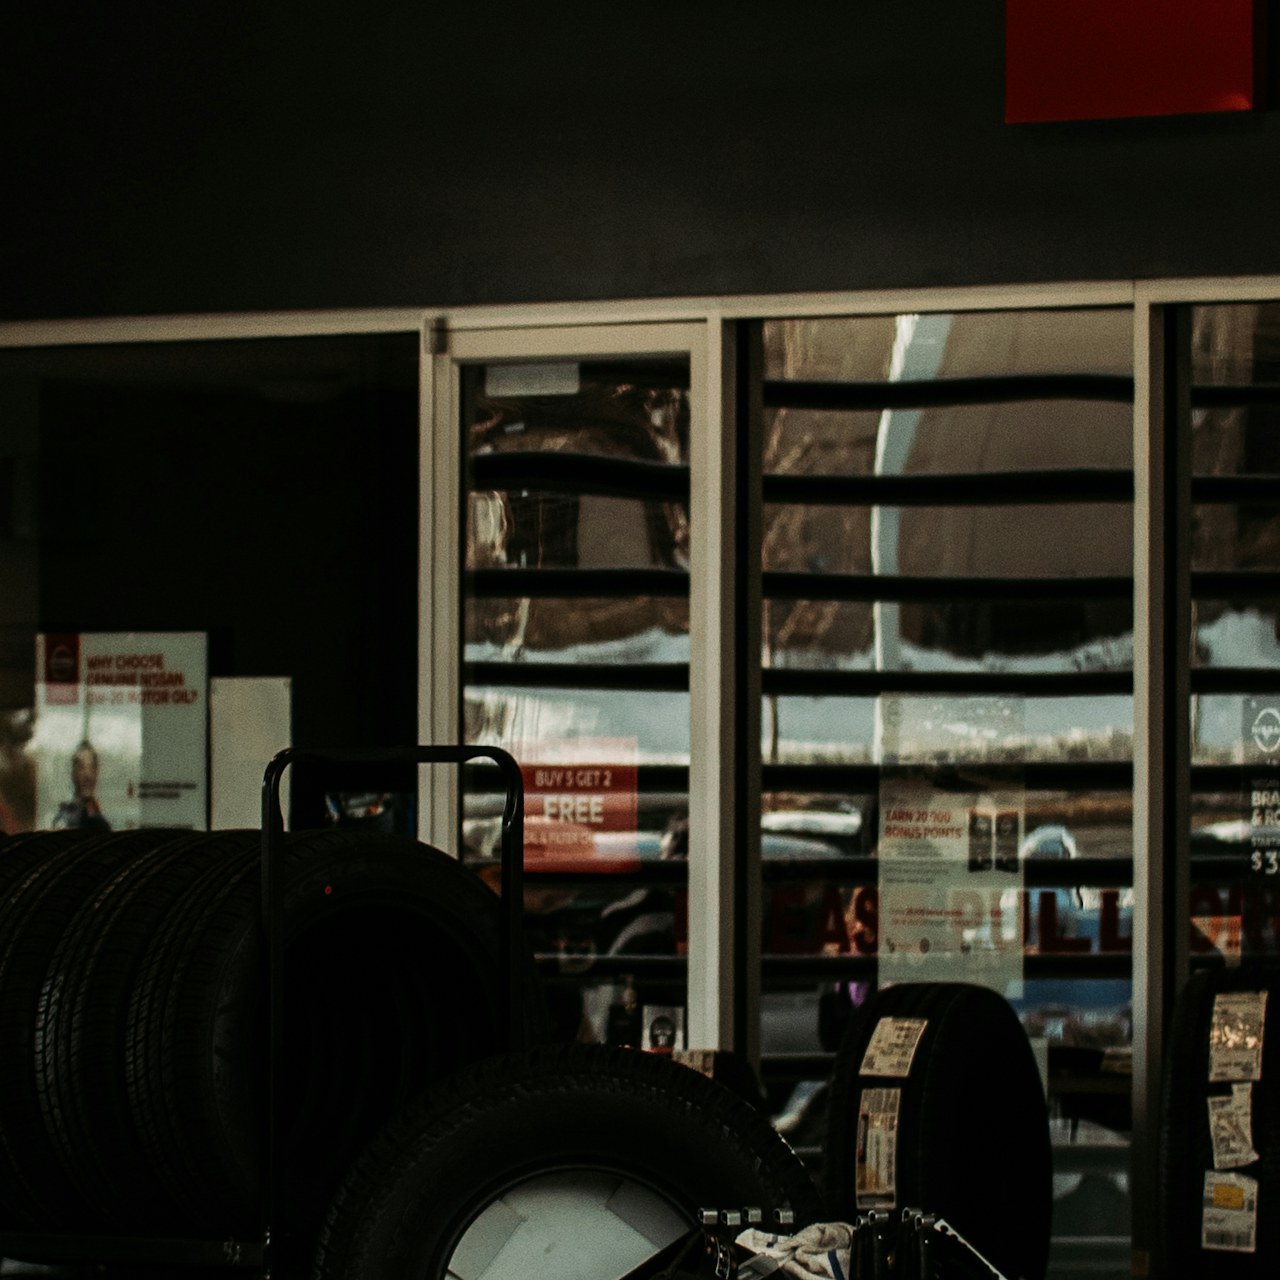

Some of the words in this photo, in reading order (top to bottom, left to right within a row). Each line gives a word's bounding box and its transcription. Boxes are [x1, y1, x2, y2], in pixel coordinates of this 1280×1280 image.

[116, 653, 164, 669] CHOOSE
[535, 770, 563, 787] BUY
[565, 770, 574, 787] 5
[575, 770, 600, 787] GET
[603, 770, 612, 787] 2
[543, 794, 605, 823] FREE
[923, 826, 962, 839] POINTS
